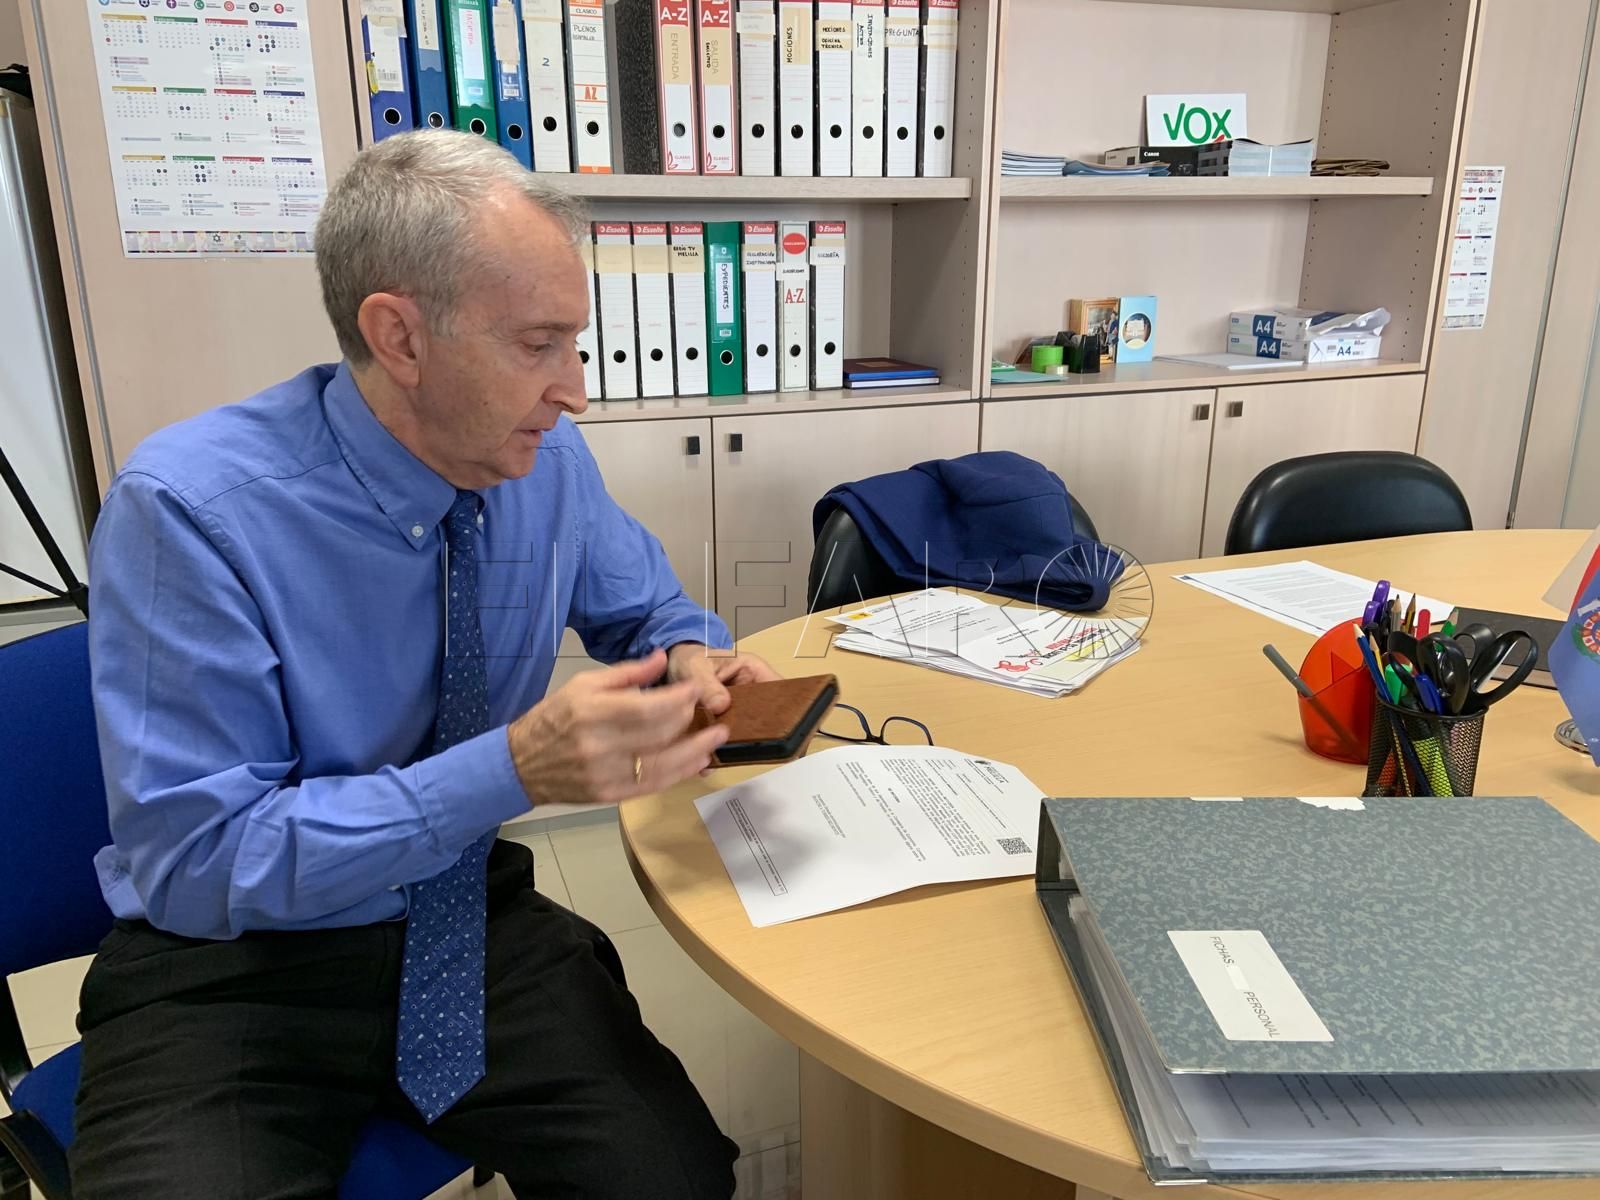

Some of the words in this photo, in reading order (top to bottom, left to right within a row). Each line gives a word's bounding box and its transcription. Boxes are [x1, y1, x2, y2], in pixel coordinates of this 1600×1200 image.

[660, 7, 688, 21] A-Z
[702, 10, 729, 24] A-Z
[542, 57, 550, 67] 2
[670, 32, 680, 80] ENTRADA
[711, 39, 719, 75] SALIDA
[584, 86, 598, 100] AZ
[1163, 102, 1232, 145] VOX
[605, 225, 628, 234] Esselte
[642, 225, 665, 234] Esselte
[680, 225, 702, 234] Esselte
[752, 225, 774, 234] Esselte
[823, 224, 843, 233] Esselte
[721, 262, 730, 311] EXPEDIENTES
[785, 287, 806, 305] A-Z
[1255, 319, 1271, 335] A4
[1260, 340, 1277, 355] A4
[1337, 345, 1352, 356] A4
[1244, 990, 1281, 1038] PERSONAL
